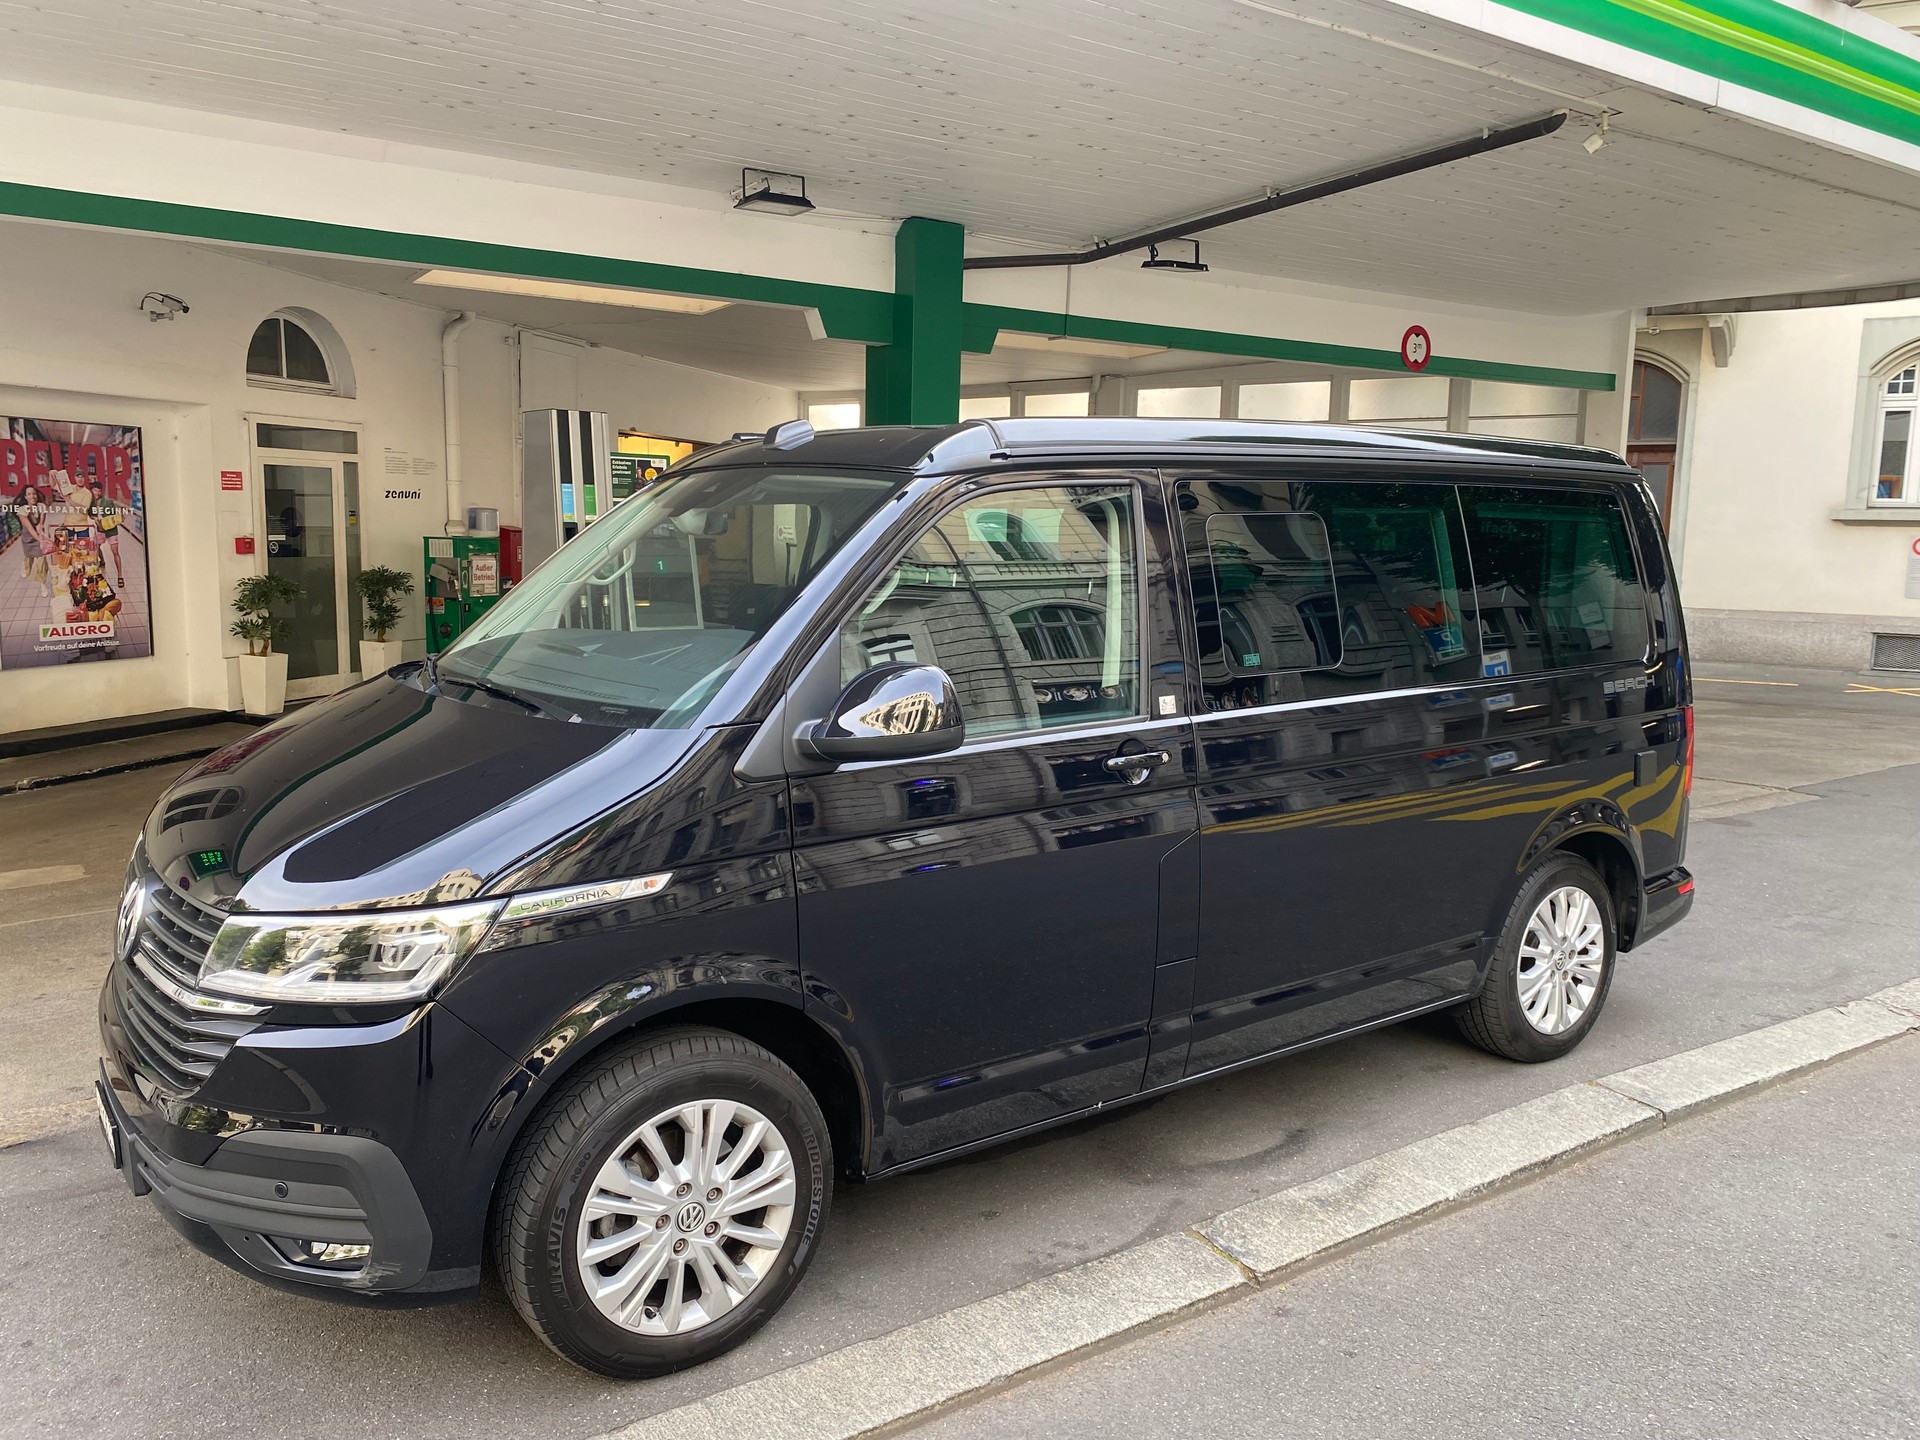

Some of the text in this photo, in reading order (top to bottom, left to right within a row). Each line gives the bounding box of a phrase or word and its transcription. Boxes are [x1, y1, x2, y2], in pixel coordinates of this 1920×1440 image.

[0, 438, 132, 501] BEVOR
[384, 488, 422, 500] zenuni
[1, 504, 135, 515] DIE GRILLPARTY BEGINNT
[475, 563, 494, 572] Außer
[473, 573, 496, 581] Betrieb
[48, 624, 112, 638] ALIGRO
[33, 643, 66, 653] Vorfreude
[78, 641, 95, 649] deine
[1602, 674, 1656, 695] BEACH
[520, 889, 611, 912] CALIFORNIA
[800, 1121, 824, 1248] BRIDGESTONE
